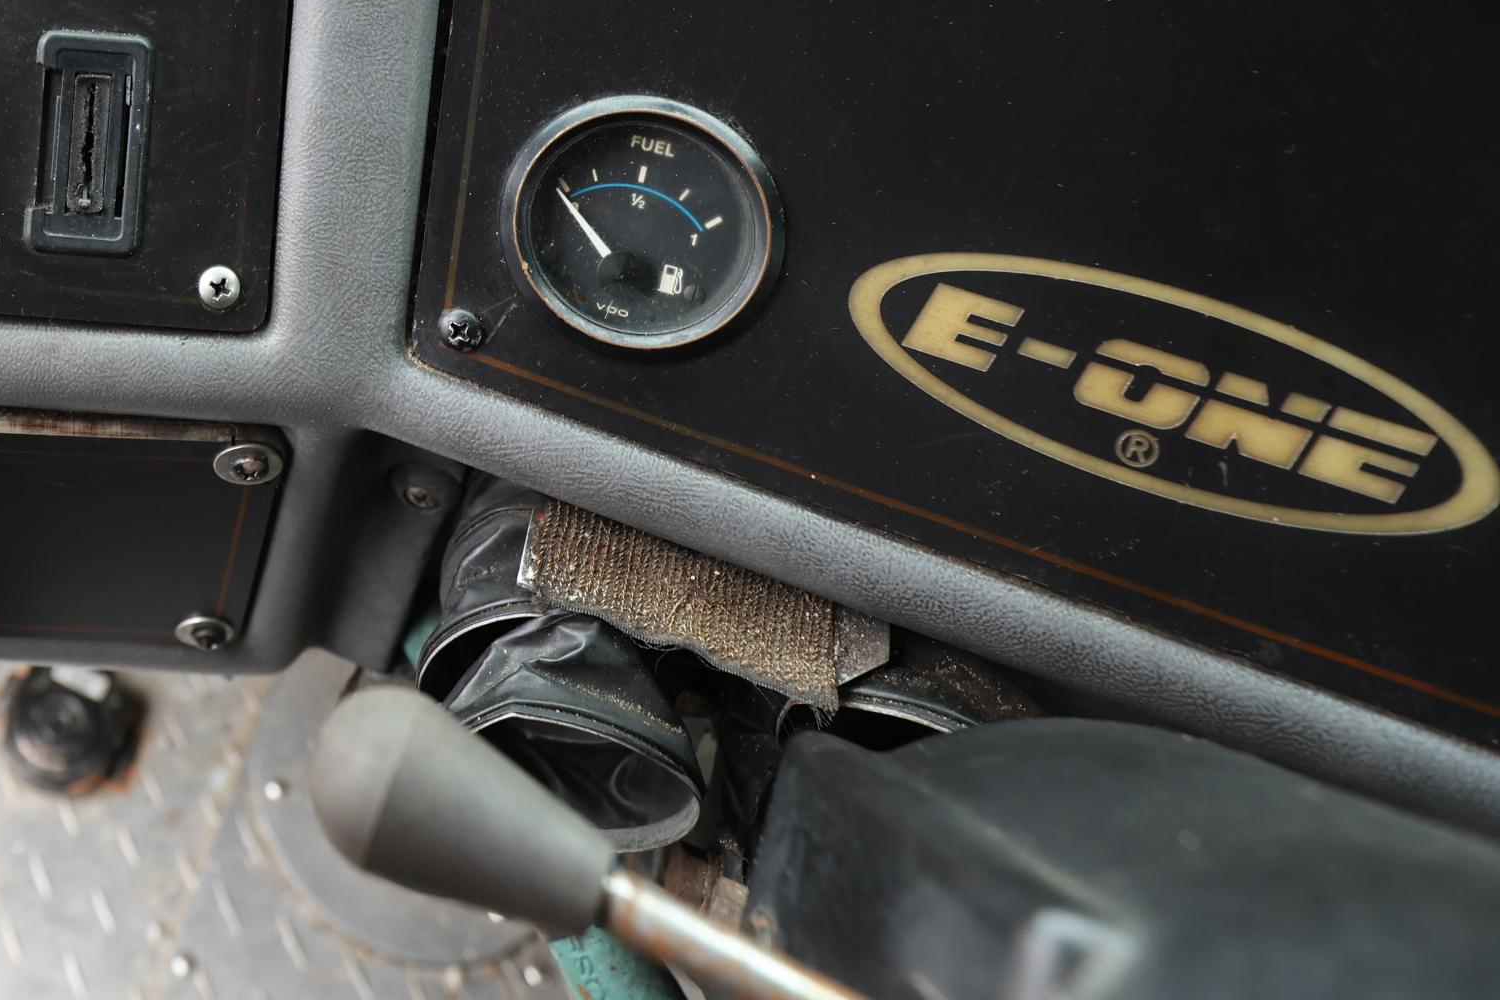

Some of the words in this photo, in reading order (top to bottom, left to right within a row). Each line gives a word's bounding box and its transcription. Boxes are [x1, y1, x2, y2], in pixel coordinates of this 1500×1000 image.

[630, 134, 675, 158] FUEL
[690, 232, 699, 247] 1
[596, 301, 629, 318] VDO
[900, 282, 1439, 505] E-ONE
